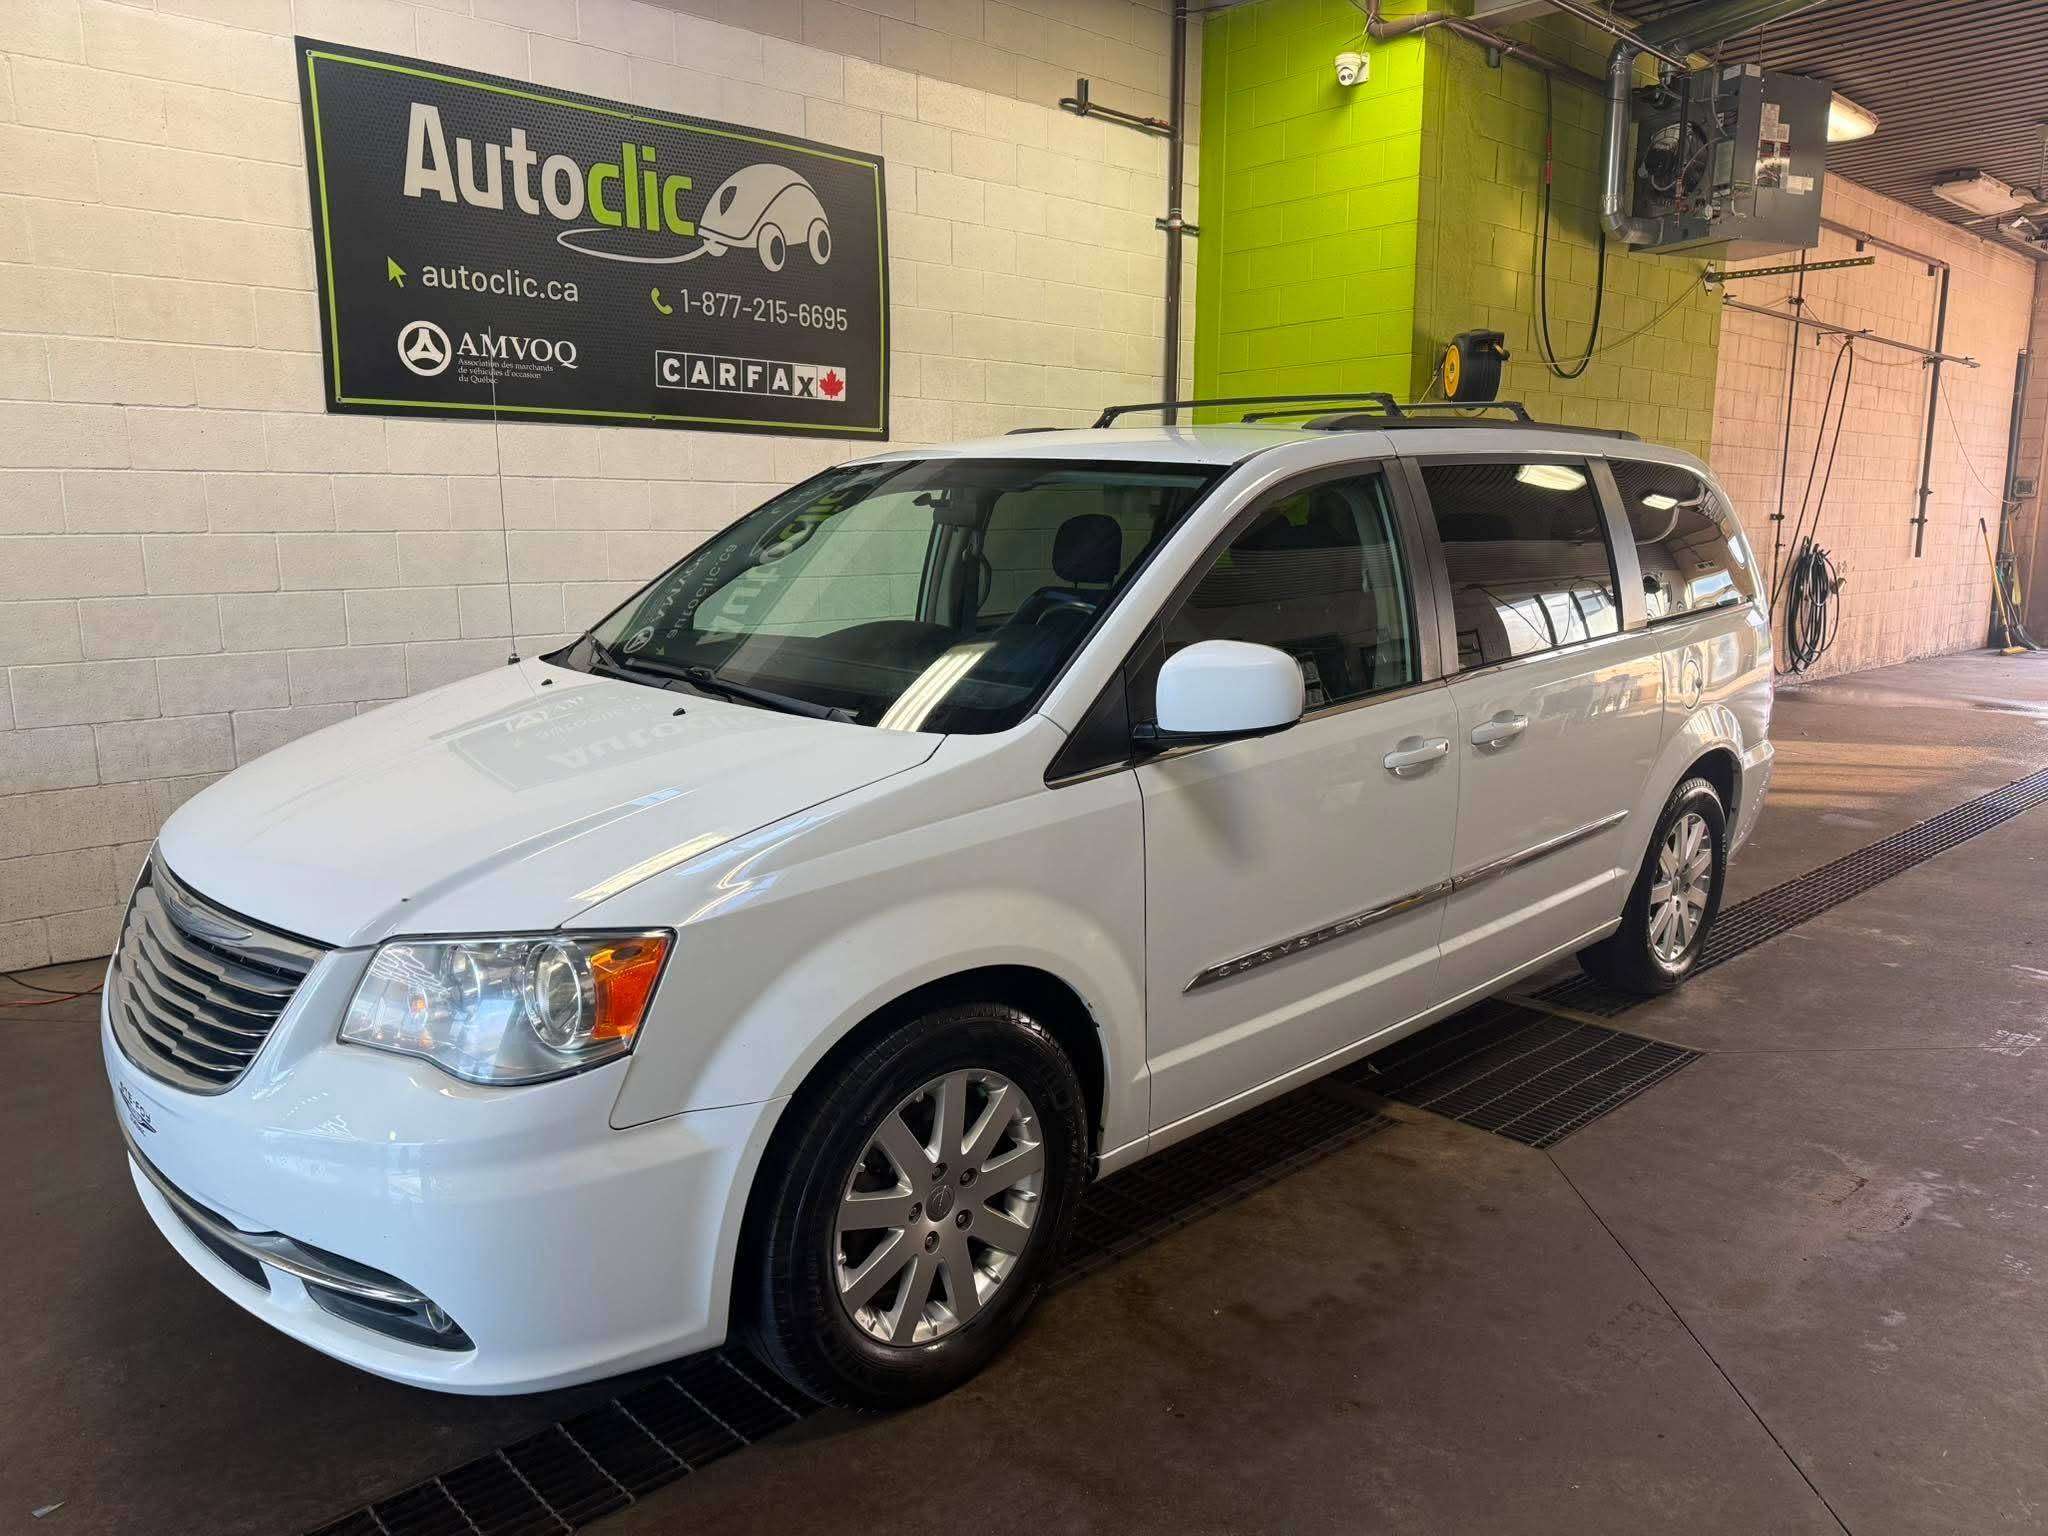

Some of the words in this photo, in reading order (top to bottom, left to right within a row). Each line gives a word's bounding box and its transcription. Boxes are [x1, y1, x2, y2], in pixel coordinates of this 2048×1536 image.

[403, 102, 695, 236] Autoclic
[422, 264, 579, 302] autoclic.ca
[680, 288, 848, 331] 1-877-215-6695
[457, 332, 578, 369] AMVOQ
[458, 366, 468, 374] de
[458, 374, 469, 382] du
[662, 357, 815, 398] CARFAX
